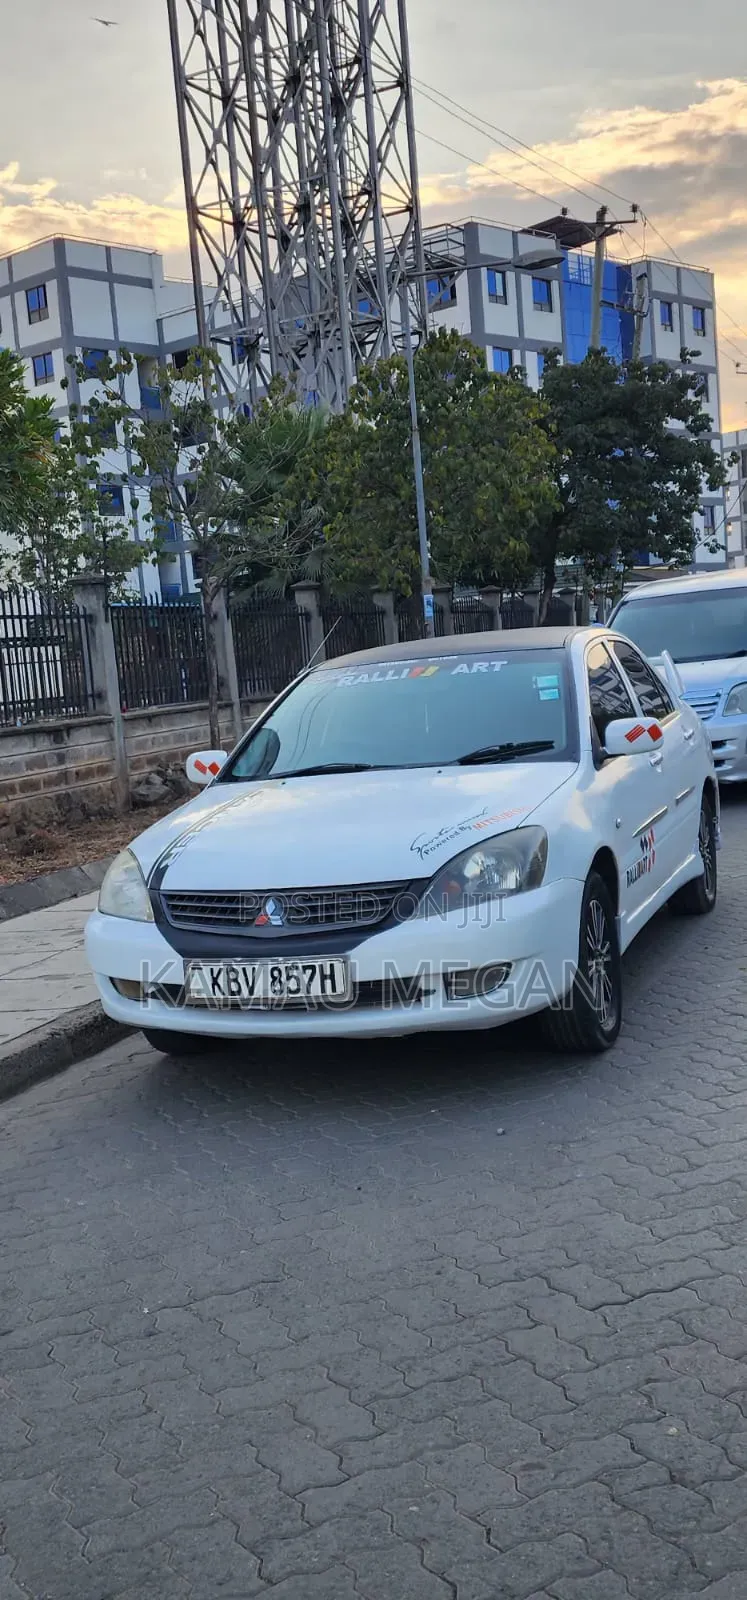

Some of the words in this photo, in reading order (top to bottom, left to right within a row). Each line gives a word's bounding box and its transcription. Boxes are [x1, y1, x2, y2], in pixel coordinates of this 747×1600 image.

[336, 667, 410, 687] RALLI
[450, 660, 508, 675] ART
[210, 966, 256, 997] KBV
[269, 963, 337, 996] 857H
